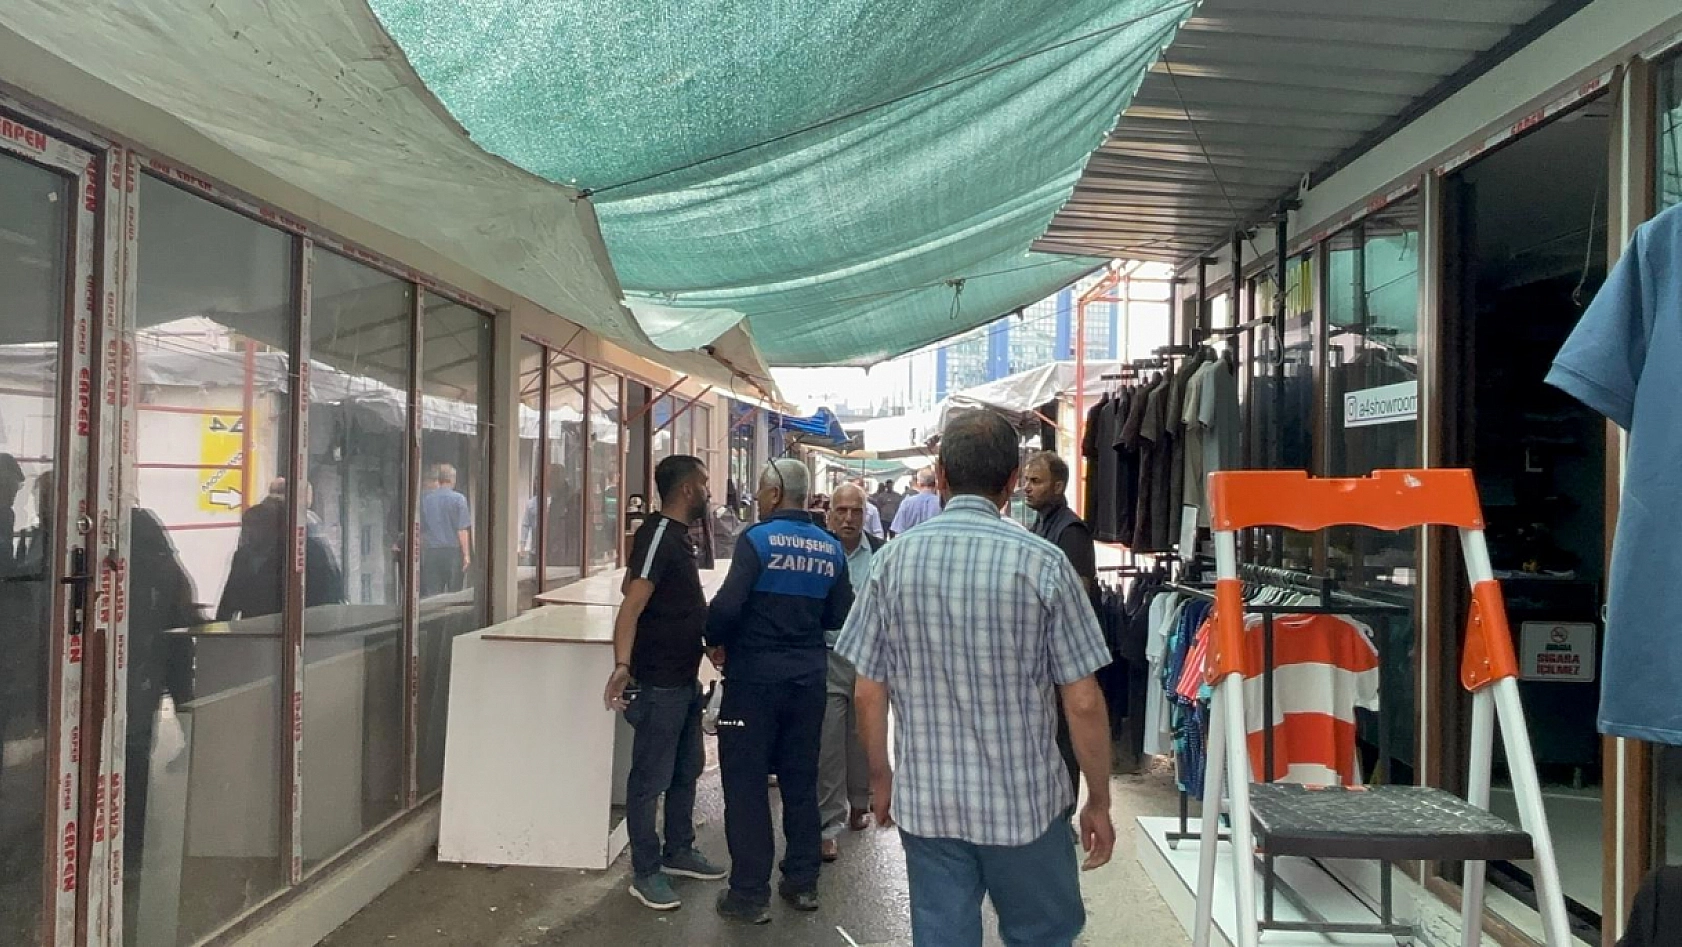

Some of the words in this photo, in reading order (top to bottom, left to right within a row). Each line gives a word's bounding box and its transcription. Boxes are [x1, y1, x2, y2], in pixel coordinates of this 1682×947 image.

[0, 118, 47, 152] RPEN
[79, 367, 90, 436] ERPEN
[767, 552, 835, 578] ZABITA
[63, 821, 76, 893] ERPEN
